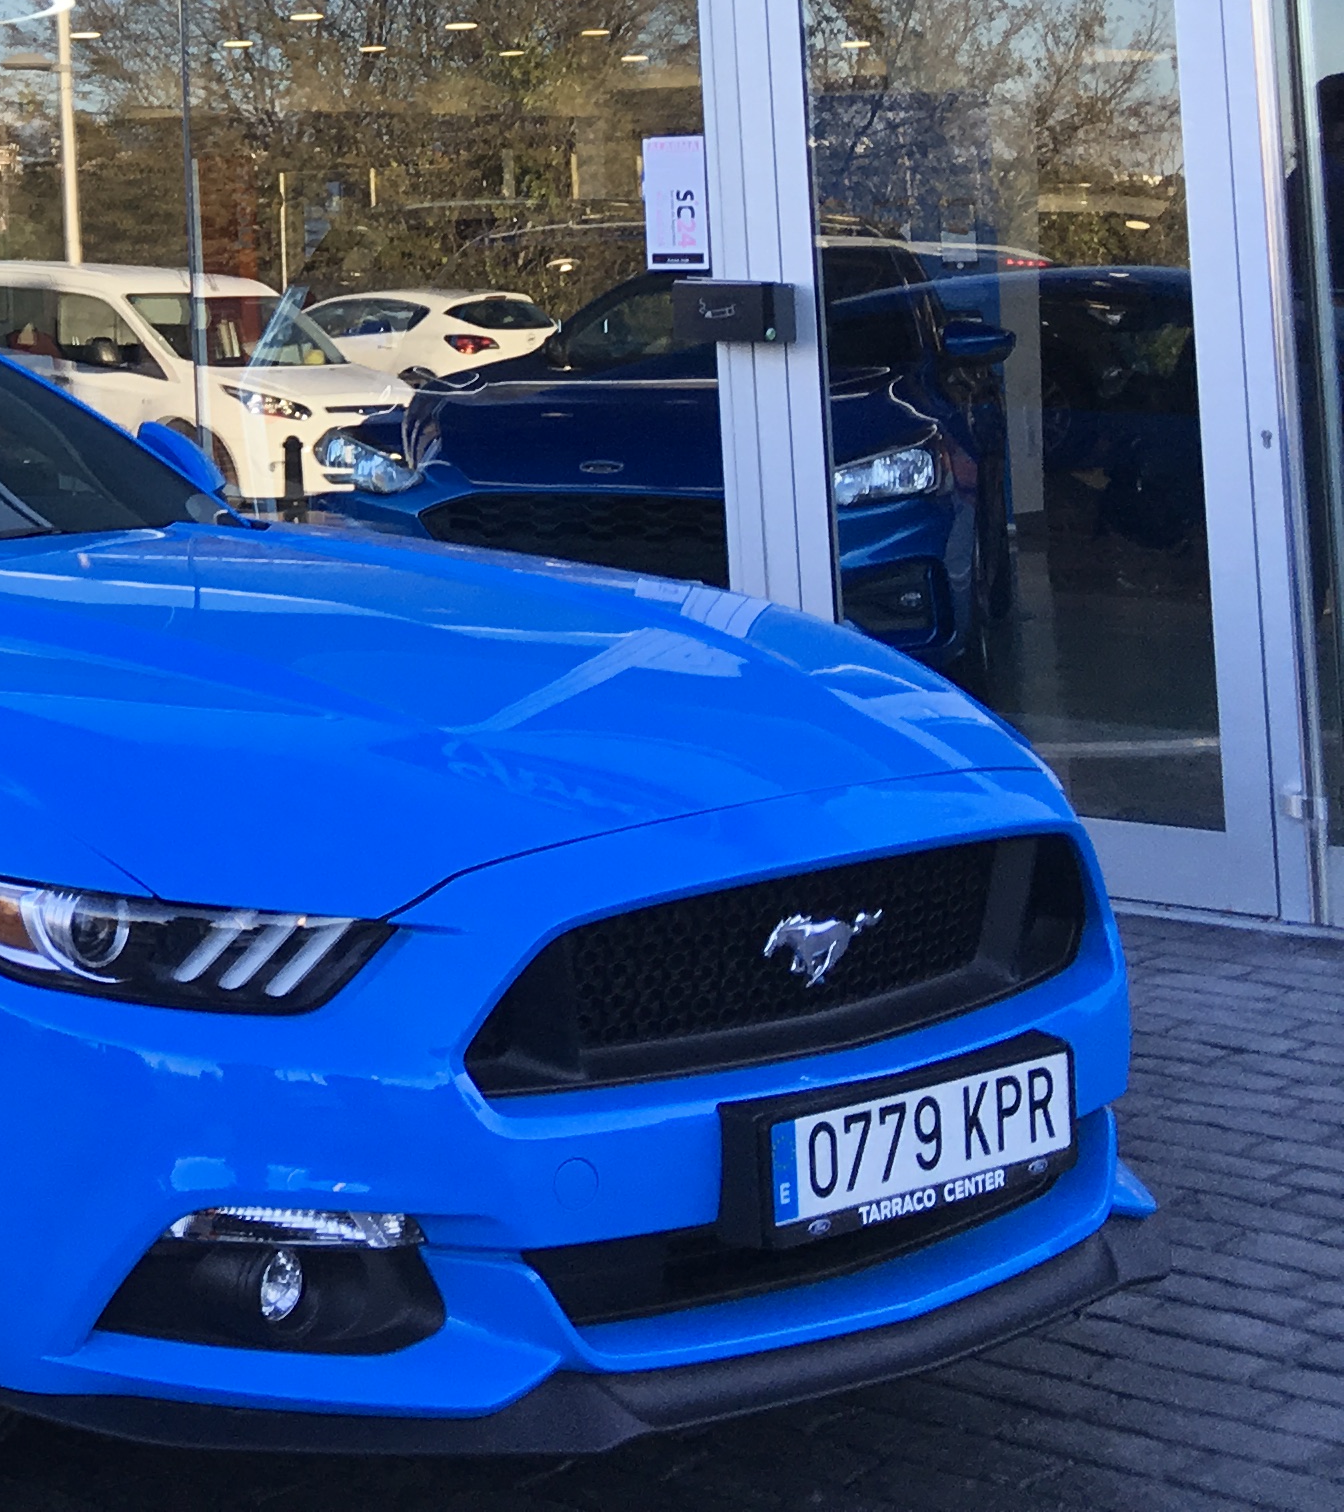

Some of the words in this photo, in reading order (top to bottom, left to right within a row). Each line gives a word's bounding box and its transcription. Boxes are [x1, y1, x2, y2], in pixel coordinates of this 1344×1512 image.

[808, 1095, 942, 1199] 0779
[963, 1067, 1056, 1161] KPR
[779, 1182, 791, 1205] E
[858, 1188, 936, 1225] TARRACO
[943, 1170, 1005, 1203] CENTER
